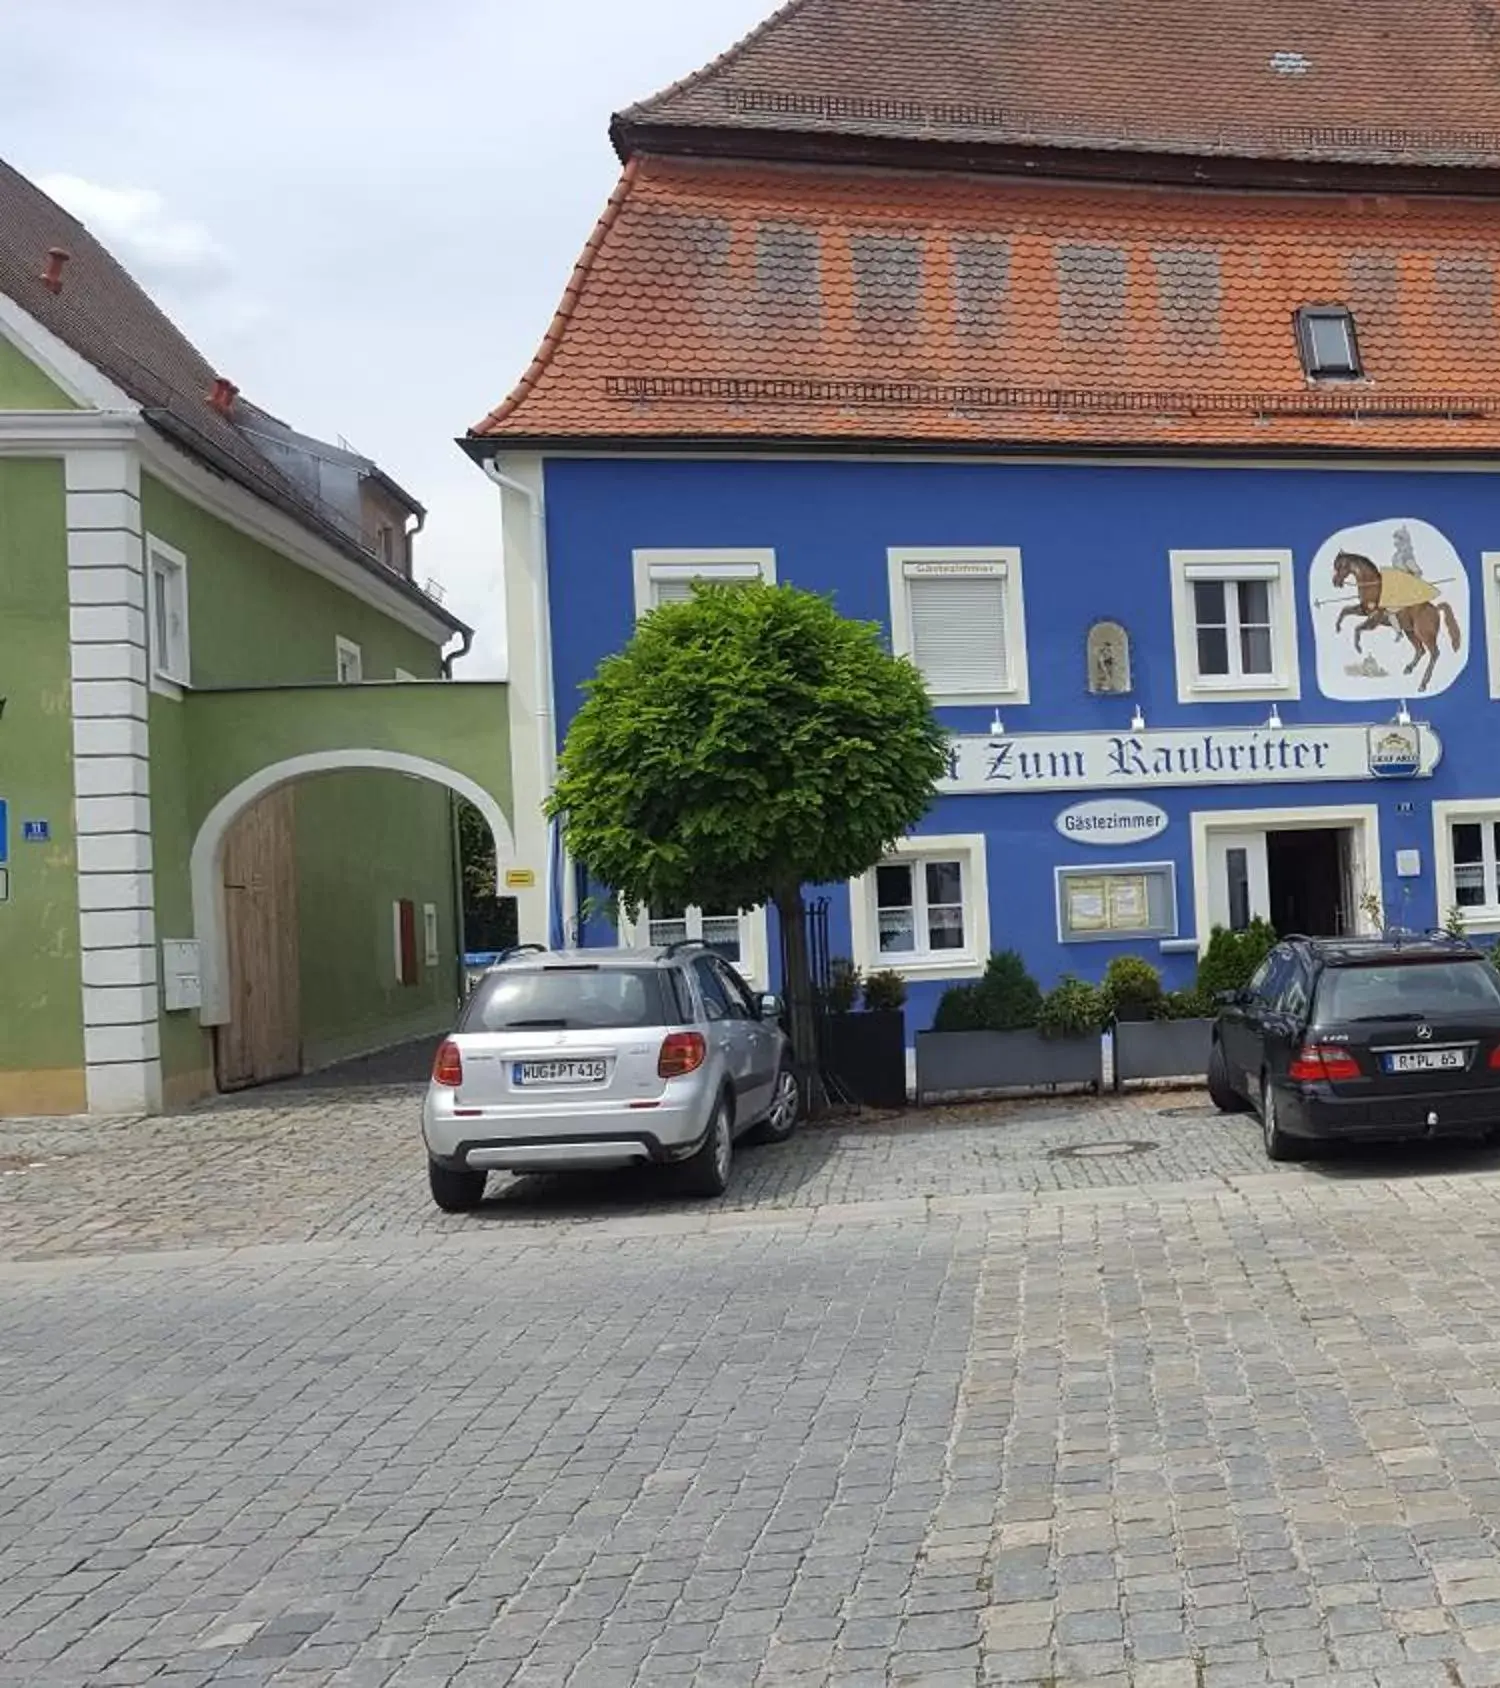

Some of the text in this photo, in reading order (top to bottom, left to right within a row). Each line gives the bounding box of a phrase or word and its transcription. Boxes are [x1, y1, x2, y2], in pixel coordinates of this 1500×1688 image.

[984, 741, 1086, 781] Zum
[1107, 733, 1330, 776] Raubritter
[1065, 811, 1162, 831] Gästezimmer
